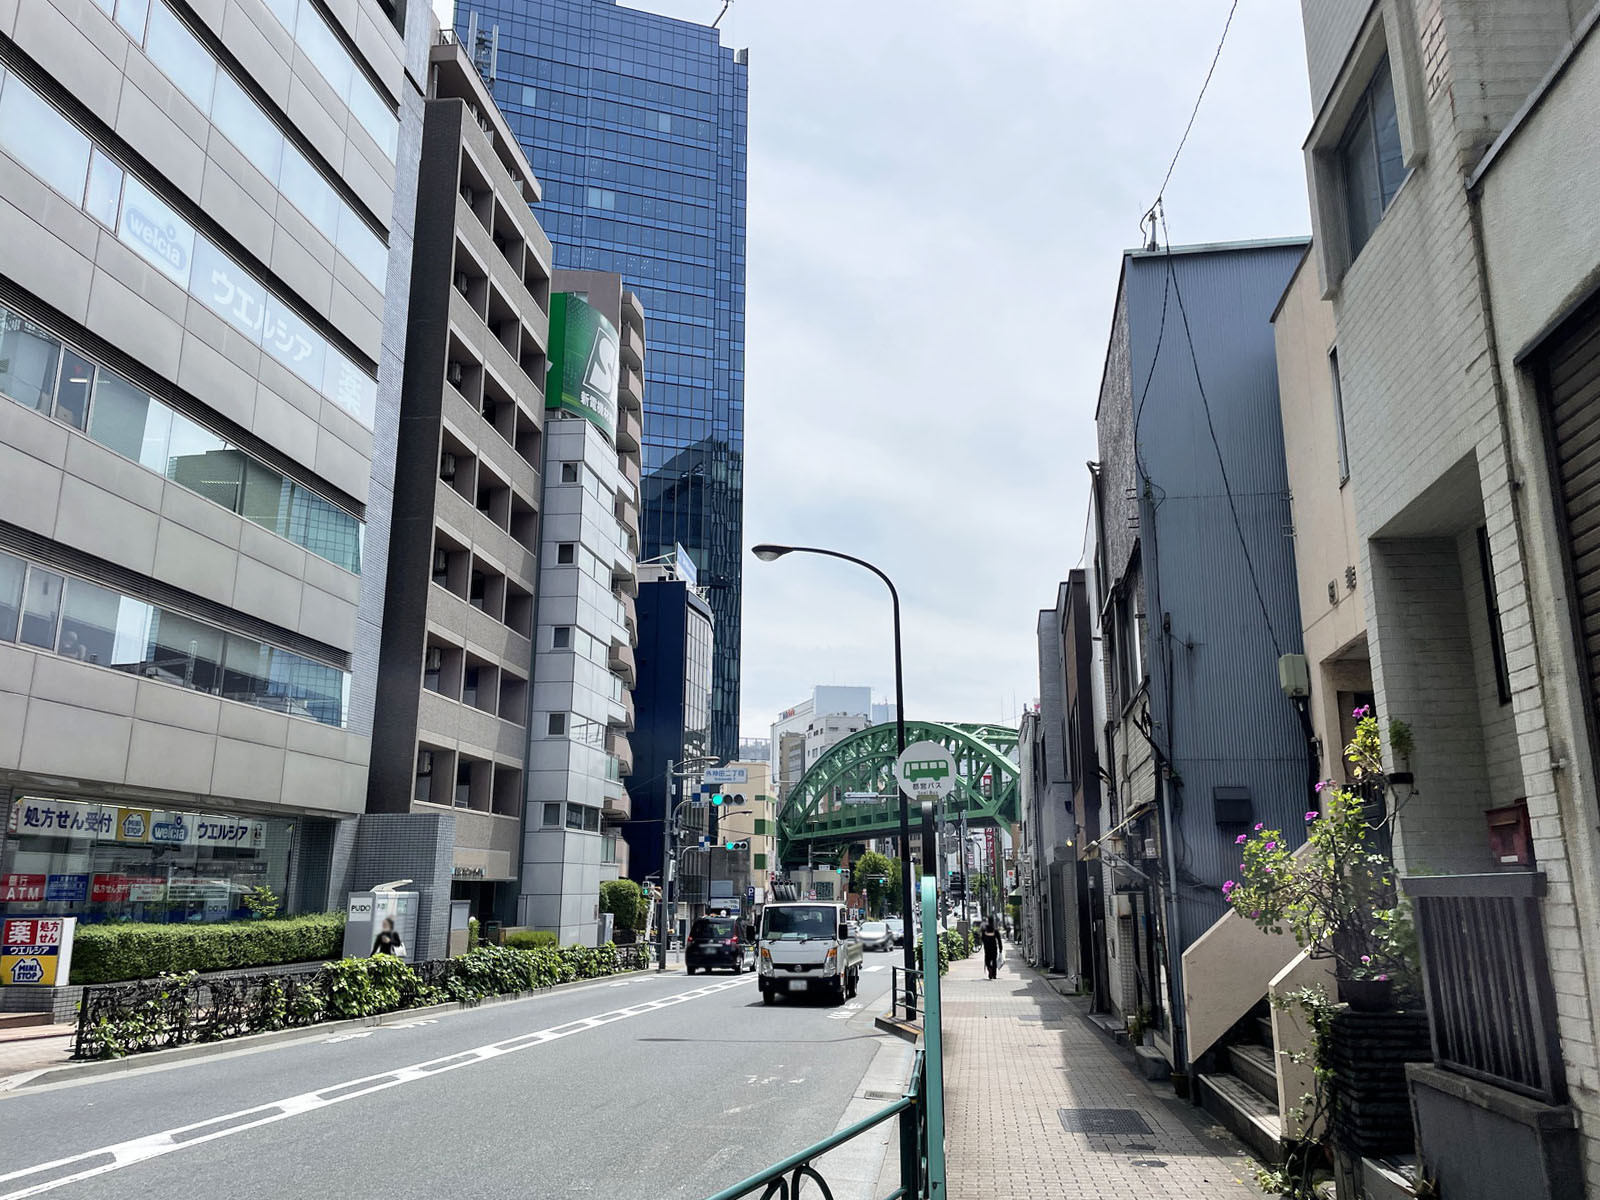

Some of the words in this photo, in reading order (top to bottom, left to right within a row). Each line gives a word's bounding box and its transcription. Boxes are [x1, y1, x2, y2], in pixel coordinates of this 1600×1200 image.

[130, 210, 182, 269] welcia
[210, 269, 312, 361] ウエルシア
[912, 782, 941, 790] 都営バス
[24, 805, 113, 833] 処方せん受付
[154, 821, 186, 841] welcia
[198, 823, 248, 841] ウエルシア
[8, 875, 28, 887] 銀行
[6, 887, 40, 900] ATM
[351, 904, 371, 912] PUDO
[8, 921, 31, 944] 薬
[40, 921, 60, 932] 処方
[39, 933, 58, 944] せん
[10, 946, 50, 955] ウエルシア
[18, 963, 38, 972] MINI
[16, 972, 38, 980] STOP
